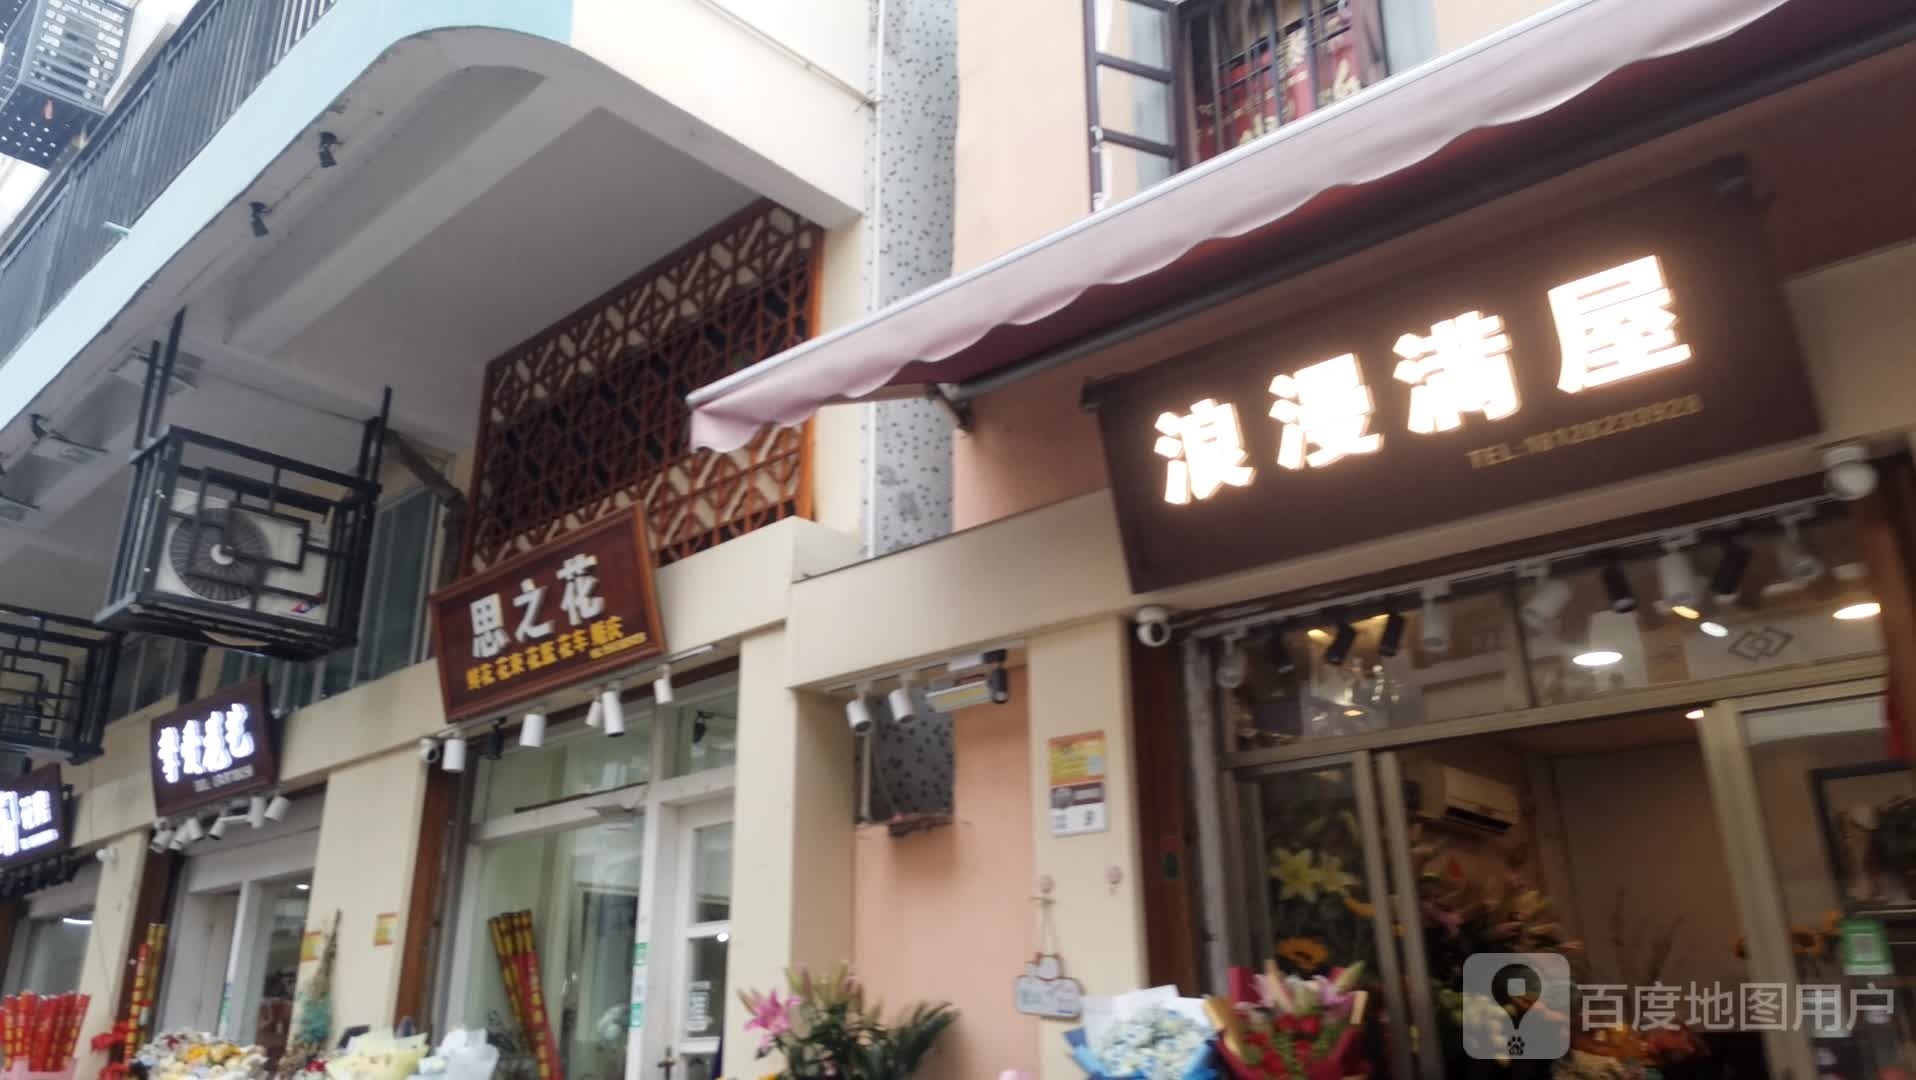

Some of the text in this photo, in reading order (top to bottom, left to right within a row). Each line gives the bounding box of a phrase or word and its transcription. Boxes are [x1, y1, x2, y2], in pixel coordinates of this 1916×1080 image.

[1154, 254, 1693, 505] 浪漫满屋
[469, 553, 605, 658] 思之花
